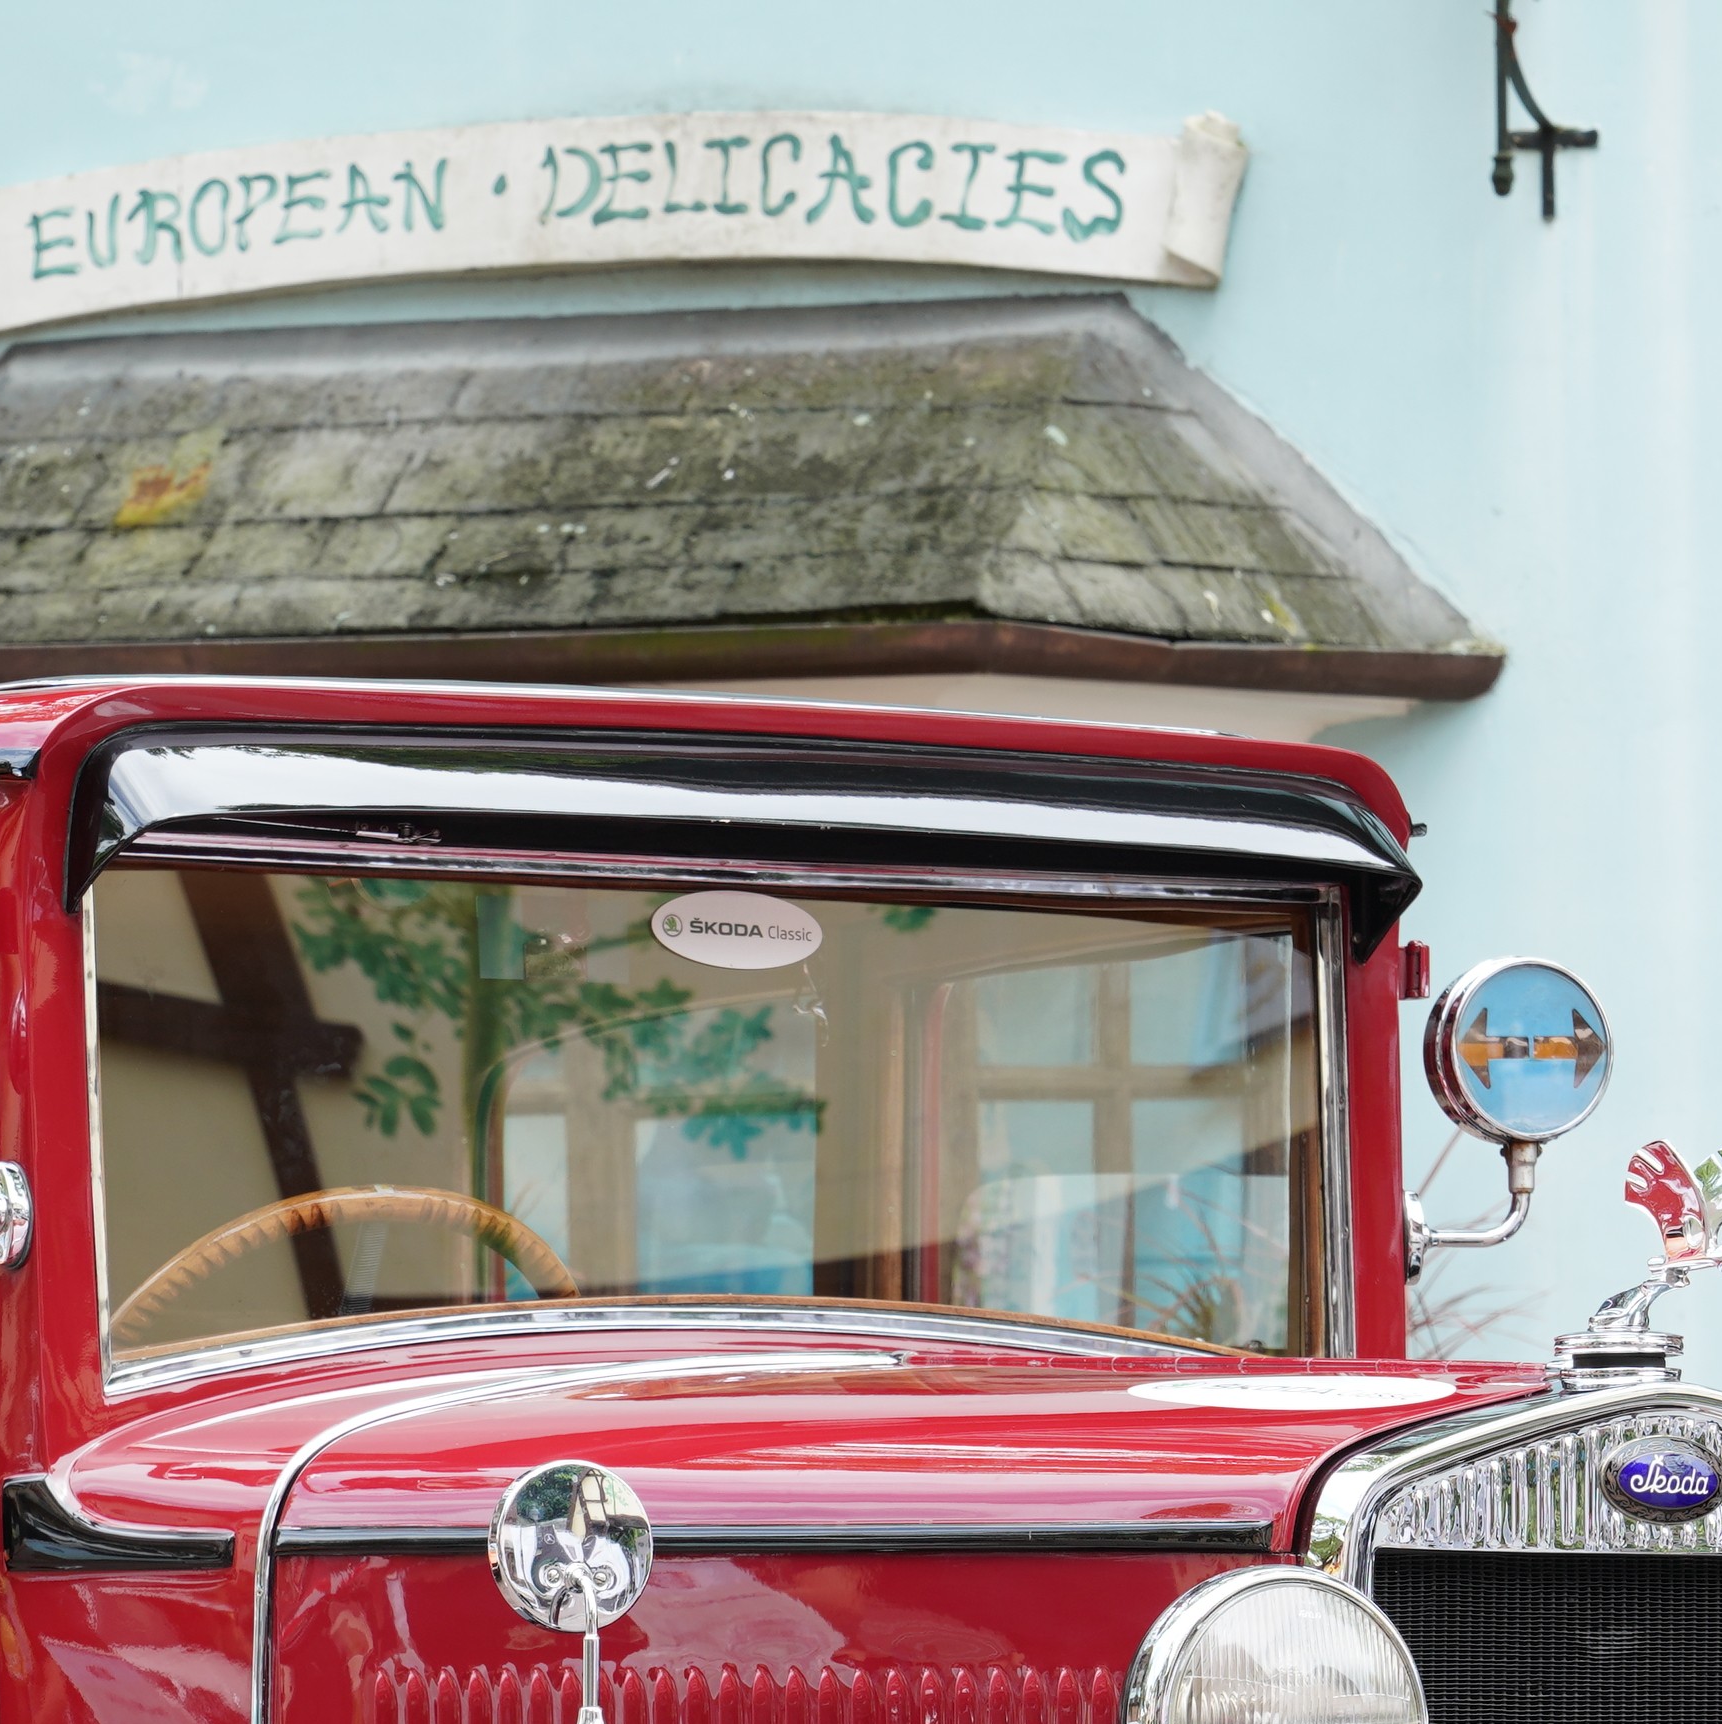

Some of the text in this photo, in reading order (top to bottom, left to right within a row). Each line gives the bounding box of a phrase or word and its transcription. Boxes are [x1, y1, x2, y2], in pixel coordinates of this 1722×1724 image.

[27, 133, 1126, 280] EUROPEAN DELICACIES
[690, 917, 812, 941] ŠKODA Classic
[1630, 1454, 1709, 1495] Škoda
